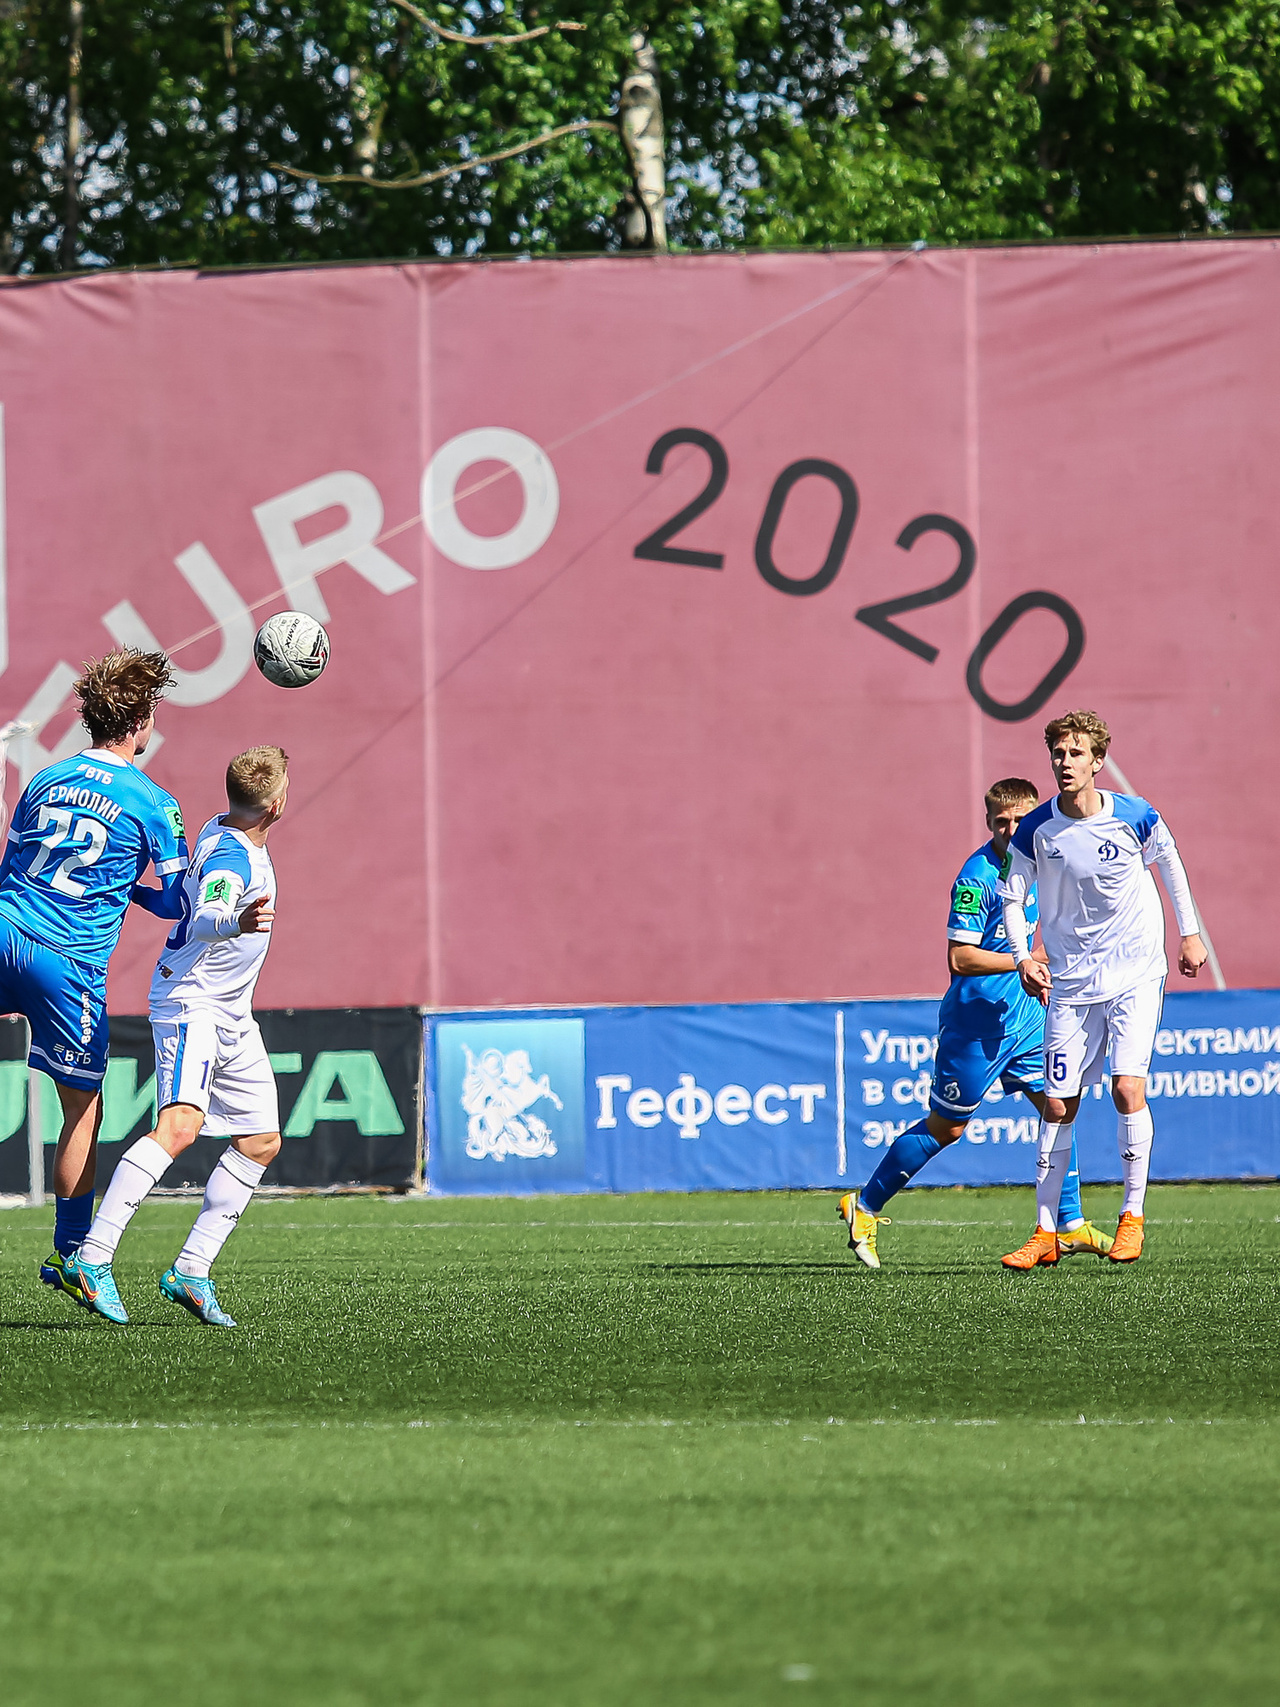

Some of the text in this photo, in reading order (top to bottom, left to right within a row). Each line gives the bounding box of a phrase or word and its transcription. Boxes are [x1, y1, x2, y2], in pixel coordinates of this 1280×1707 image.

[634, 427, 1086, 723] 2020
[285, 618, 300, 649] DEMIX
[84, 766, 115, 786] ВТБ
[48, 785, 123, 824] ЕРМОЛИН
[26, 804, 109, 899] 72
[80, 991, 93, 1045] BetBoom
[64, 1049, 92, 1066] ВТБ
[859, 1026, 1280, 1071] Упр ектами
[1044, 1051, 1068, 1082] 15
[595, 1072, 827, 1139] Гефест
[861, 1077, 886, 1107] в
[1096, 1060, 1280, 1100] ливной
